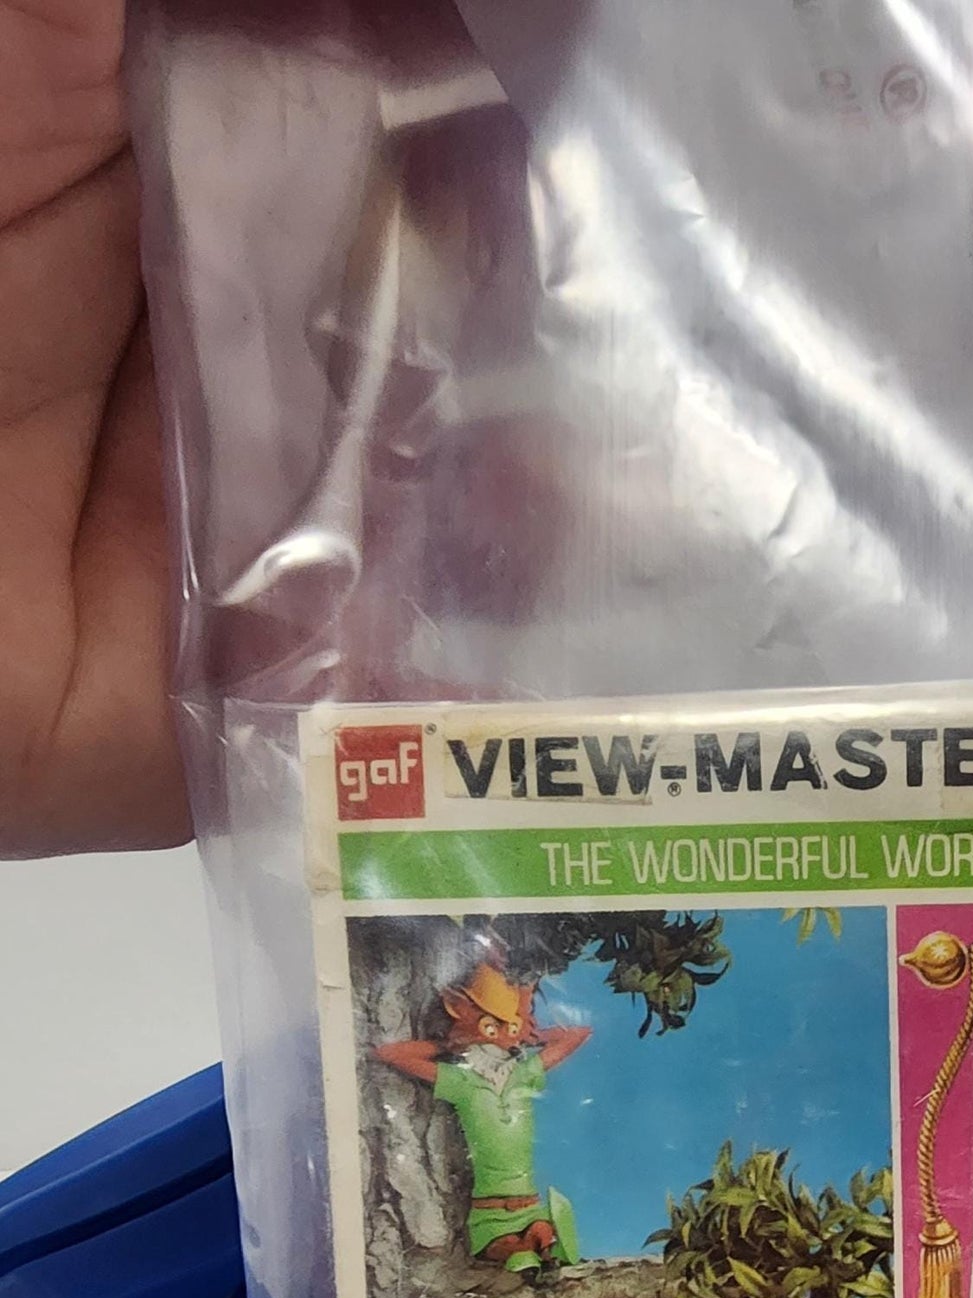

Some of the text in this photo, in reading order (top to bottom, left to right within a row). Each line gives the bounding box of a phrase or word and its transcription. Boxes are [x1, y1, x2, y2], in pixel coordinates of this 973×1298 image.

[338, 741, 419, 802] gaf
[540, 839, 613, 886] THE
[628, 834, 871, 884] WONDERFUL
